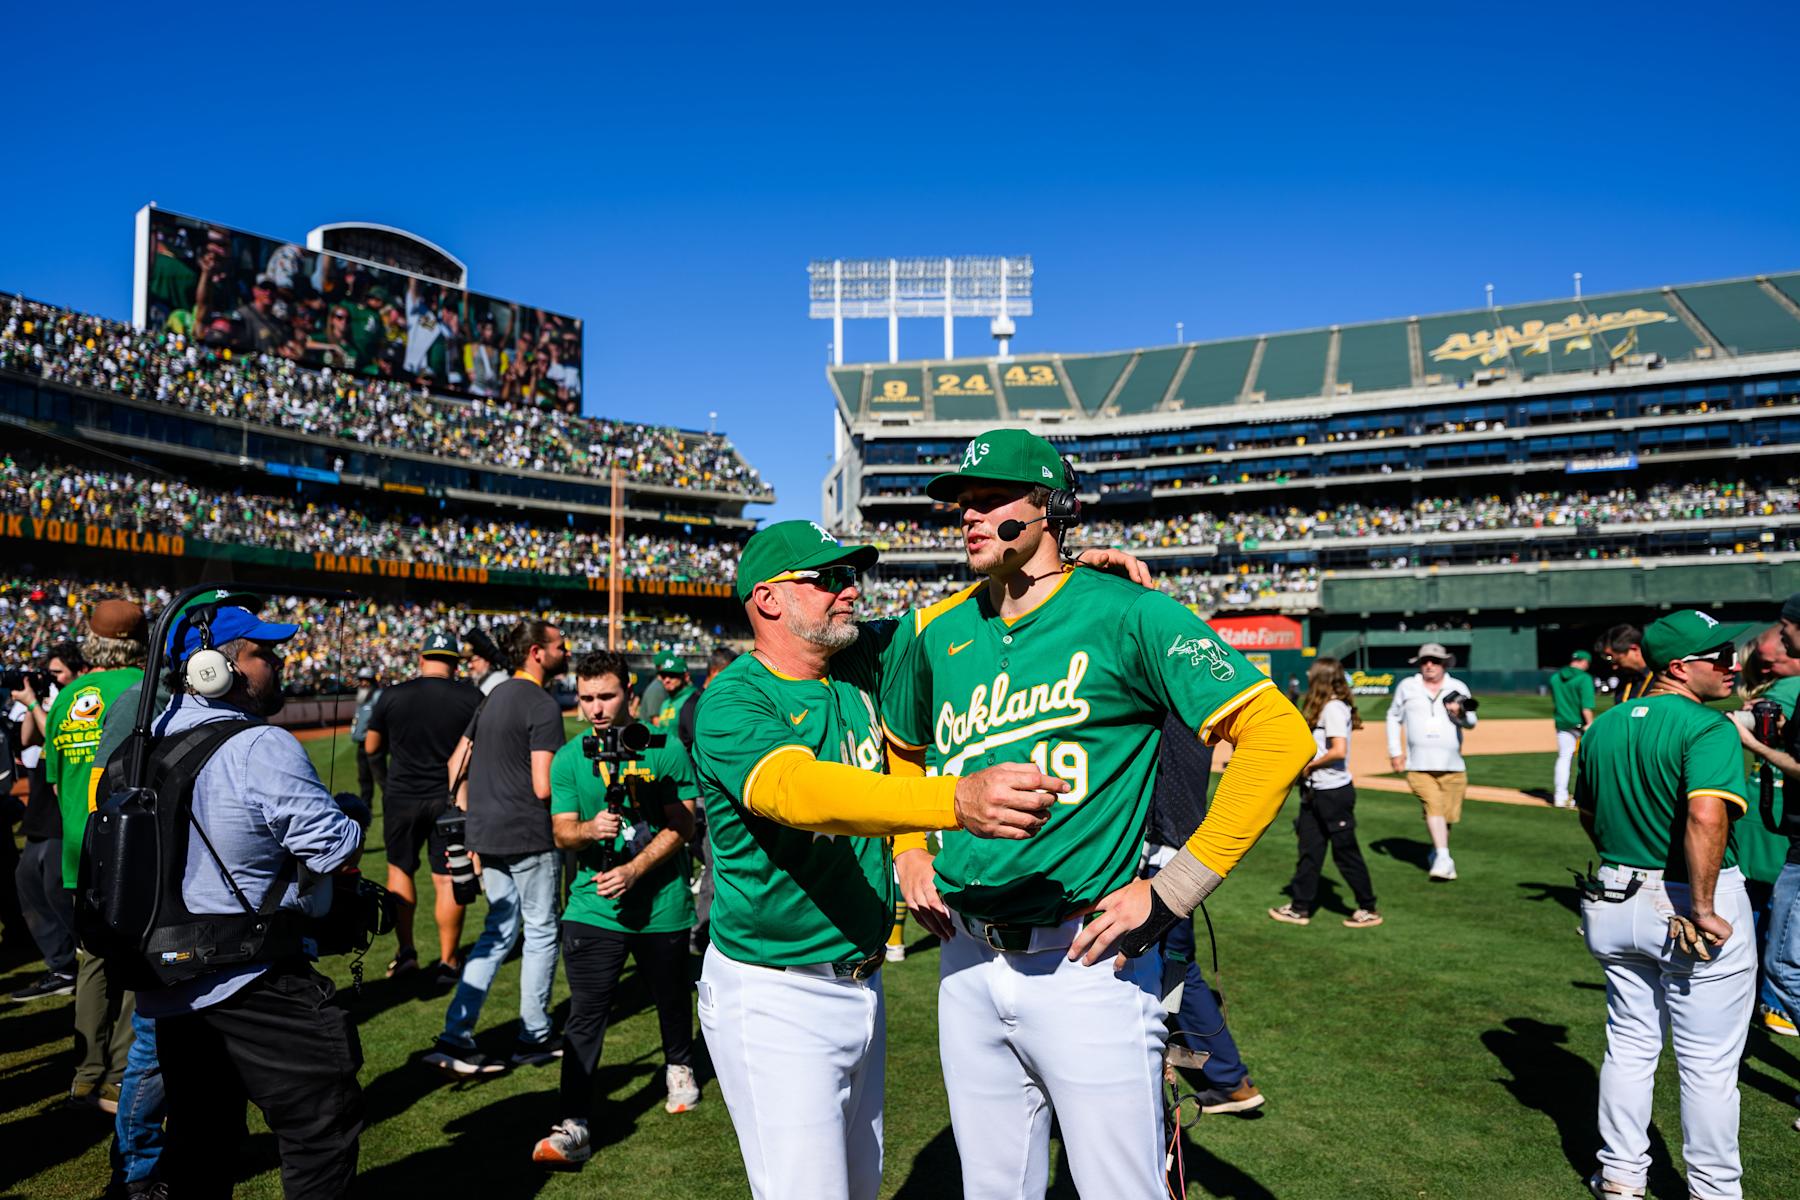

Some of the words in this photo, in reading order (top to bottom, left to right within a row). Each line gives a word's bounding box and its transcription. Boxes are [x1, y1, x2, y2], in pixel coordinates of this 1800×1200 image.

[883, 380, 908, 397] 9
[938, 374, 989, 391] 24
[1005, 366, 1054, 382] 43
[960, 440, 990, 473] A's
[32, 517, 78, 544] YOU
[85, 524, 184, 556] OAKLAND
[314, 552, 373, 575] THANK
[378, 559, 411, 578] YOU
[414, 562, 488, 584] OAKLAND
[639, 578, 665, 594] YOU
[669, 582, 732, 597] OAKLAND
[936, 651, 1090, 755] Oakland
[1030, 741, 1089, 804] 19
